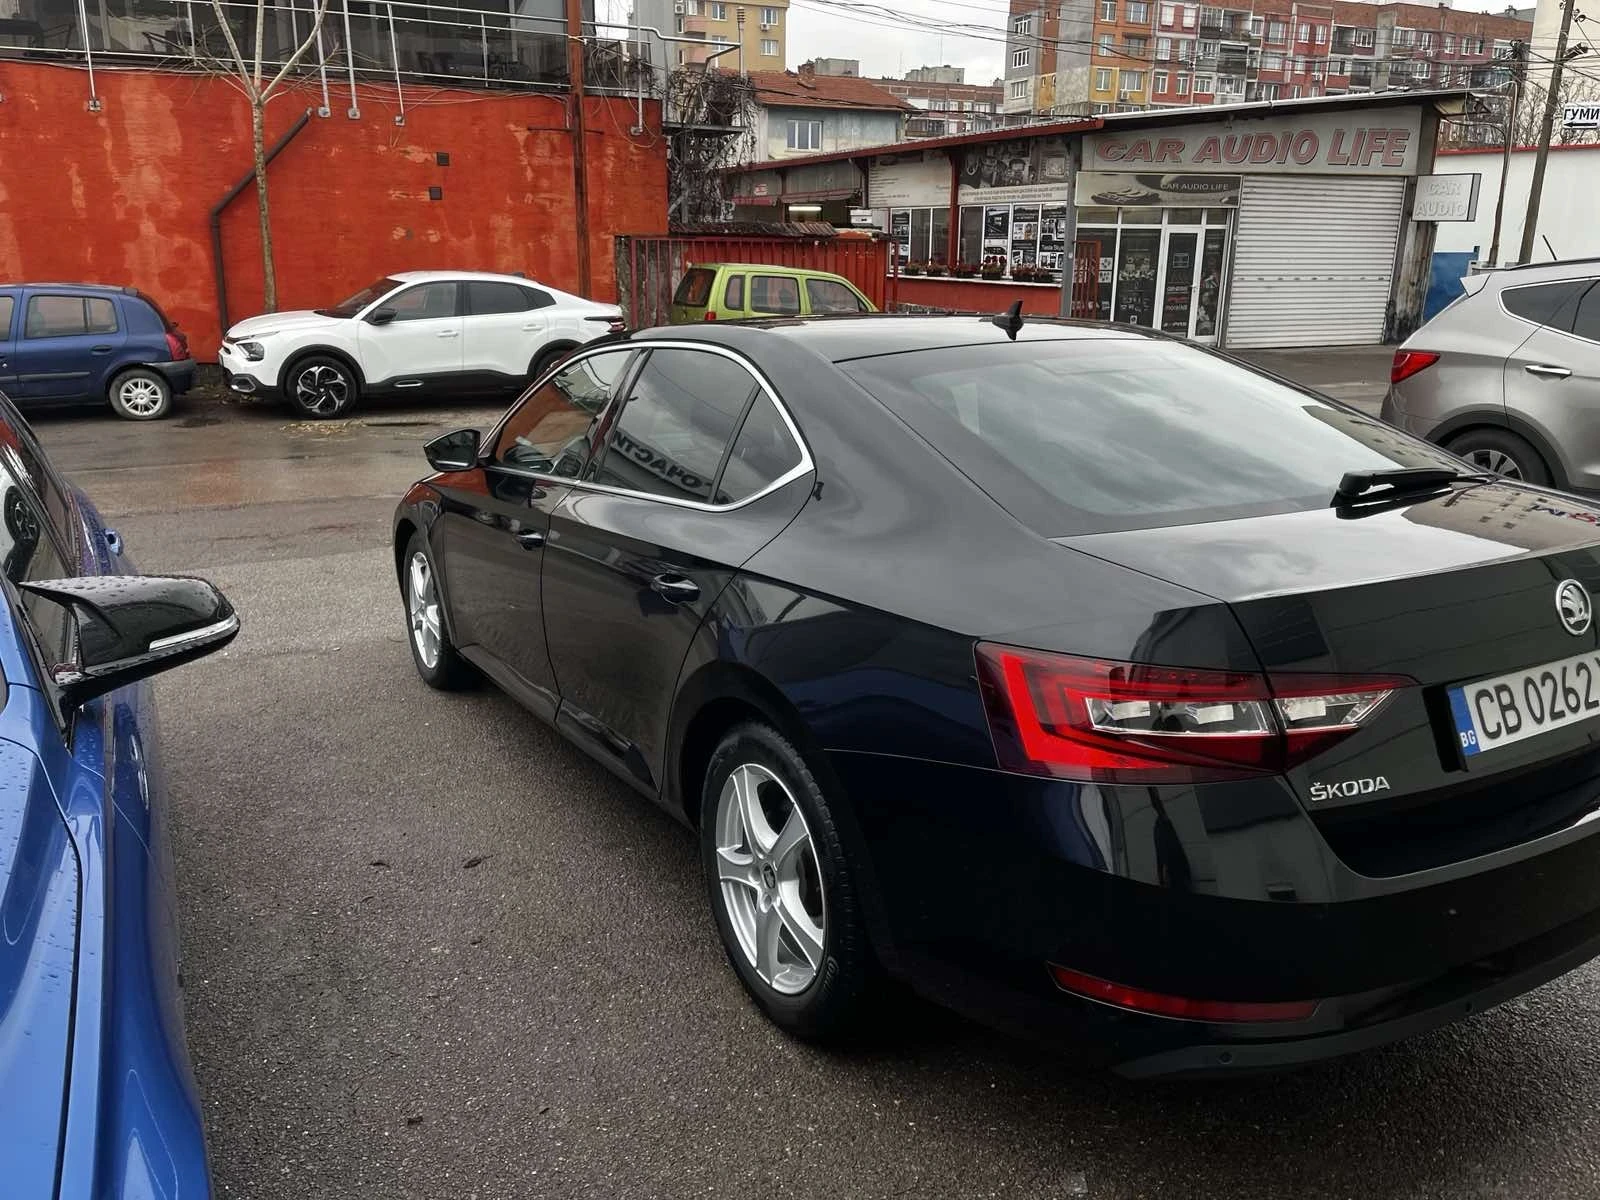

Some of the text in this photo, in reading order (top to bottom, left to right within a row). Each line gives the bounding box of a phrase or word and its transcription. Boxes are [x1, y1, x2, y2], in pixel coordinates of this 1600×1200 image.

[1563, 108, 1600, 121] ГУМИ
[1099, 127, 1411, 167] CAR AUDIO LIFE
[1210, 183, 1230, 191] LIFE
[1428, 180, 1462, 196] CAR
[1415, 201, 1468, 217] AUDIO
[1474, 662, 1600, 740] CB 0262
[1460, 730, 1477, 748] BG
[1310, 775, 1391, 801] ŠKODA
